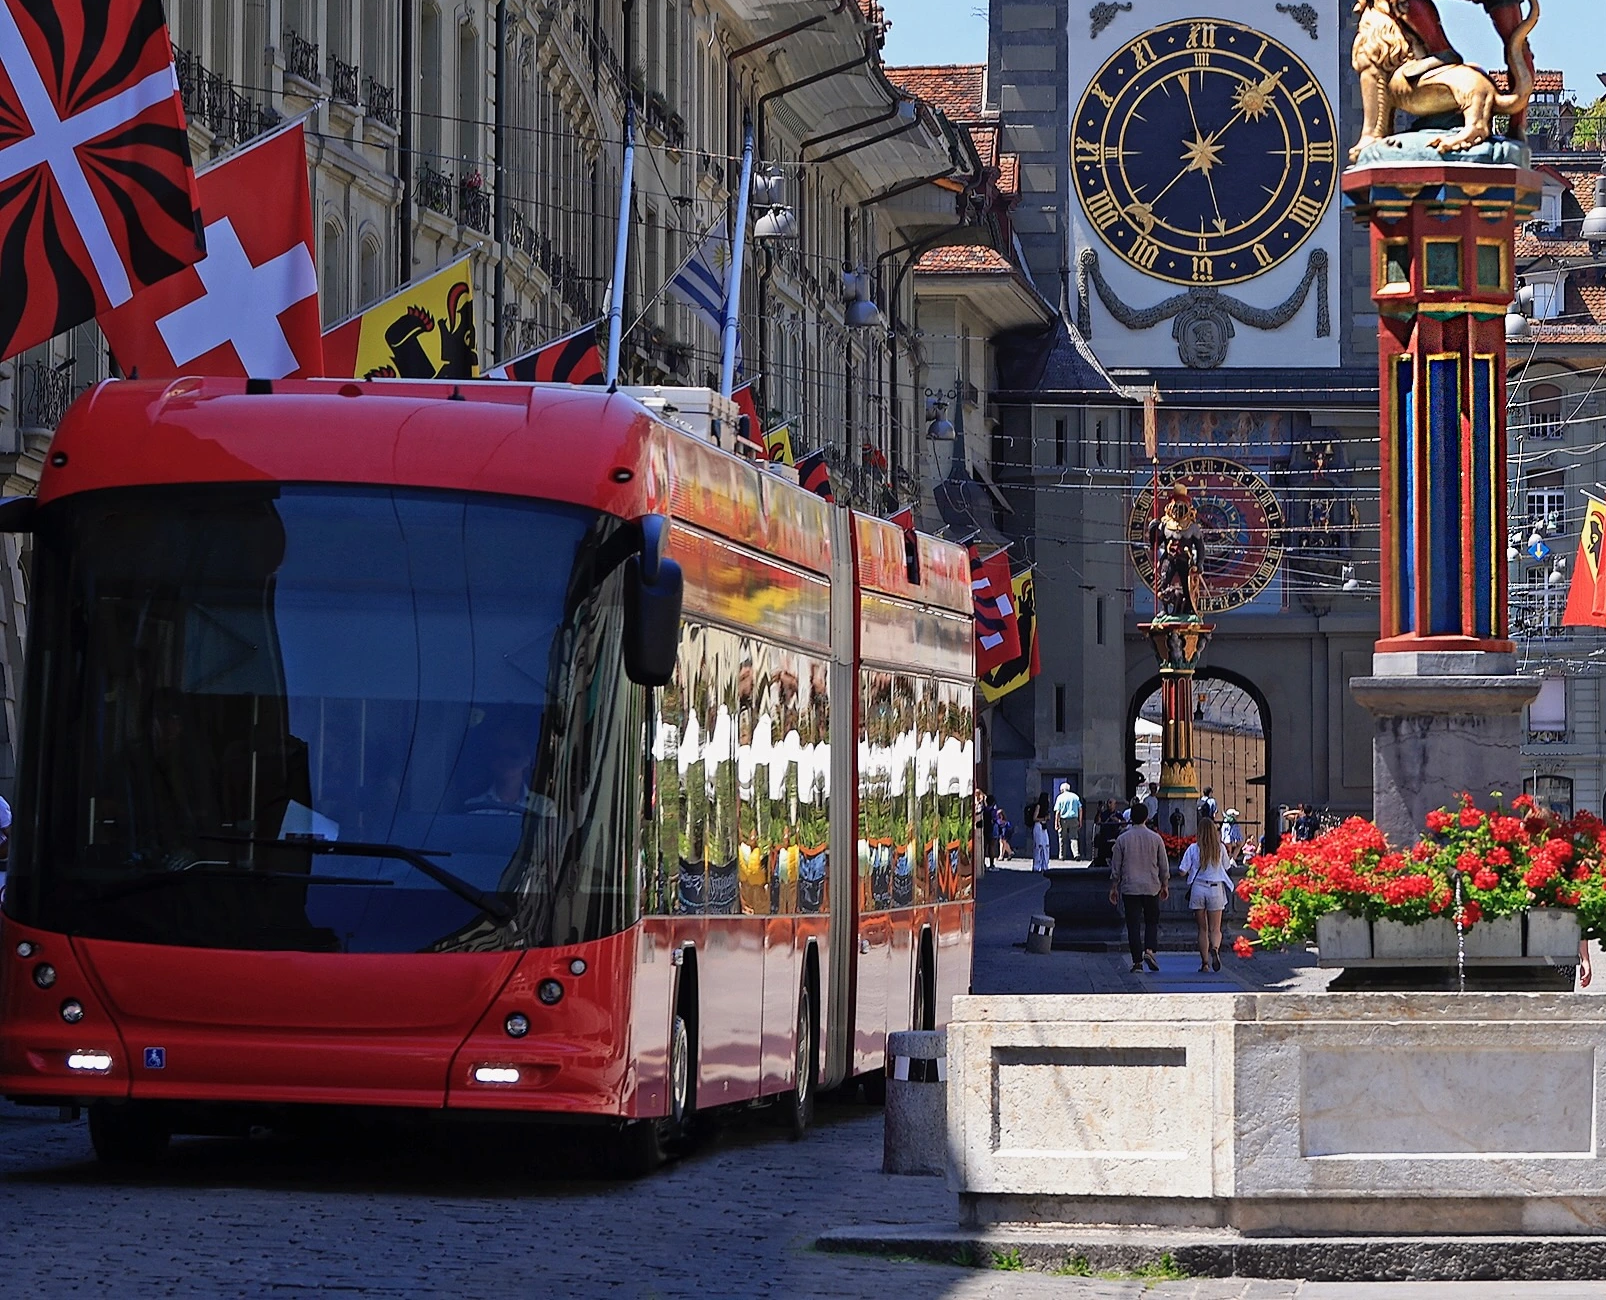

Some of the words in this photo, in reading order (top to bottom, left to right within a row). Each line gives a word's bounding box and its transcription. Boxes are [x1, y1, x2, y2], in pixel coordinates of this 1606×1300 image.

[1185, 23, 1216, 49] XII
[1130, 39, 1158, 71] XI
[1194, 52, 1210, 68] IIII
[1253, 40, 1268, 63] I
[1091, 83, 1114, 109] X
[1292, 80, 1317, 105] II
[1075, 136, 1100, 162] IX
[1104, 146, 1119, 159] III
[1308, 140, 1333, 163] III
[1086, 189, 1119, 231] VIII
[1288, 194, 1322, 228] IIII
[1127, 235, 1160, 269] VII
[1198, 238, 1208, 252] II
[1252, 243, 1273, 267] V
[1191, 256, 1214, 281] VI
